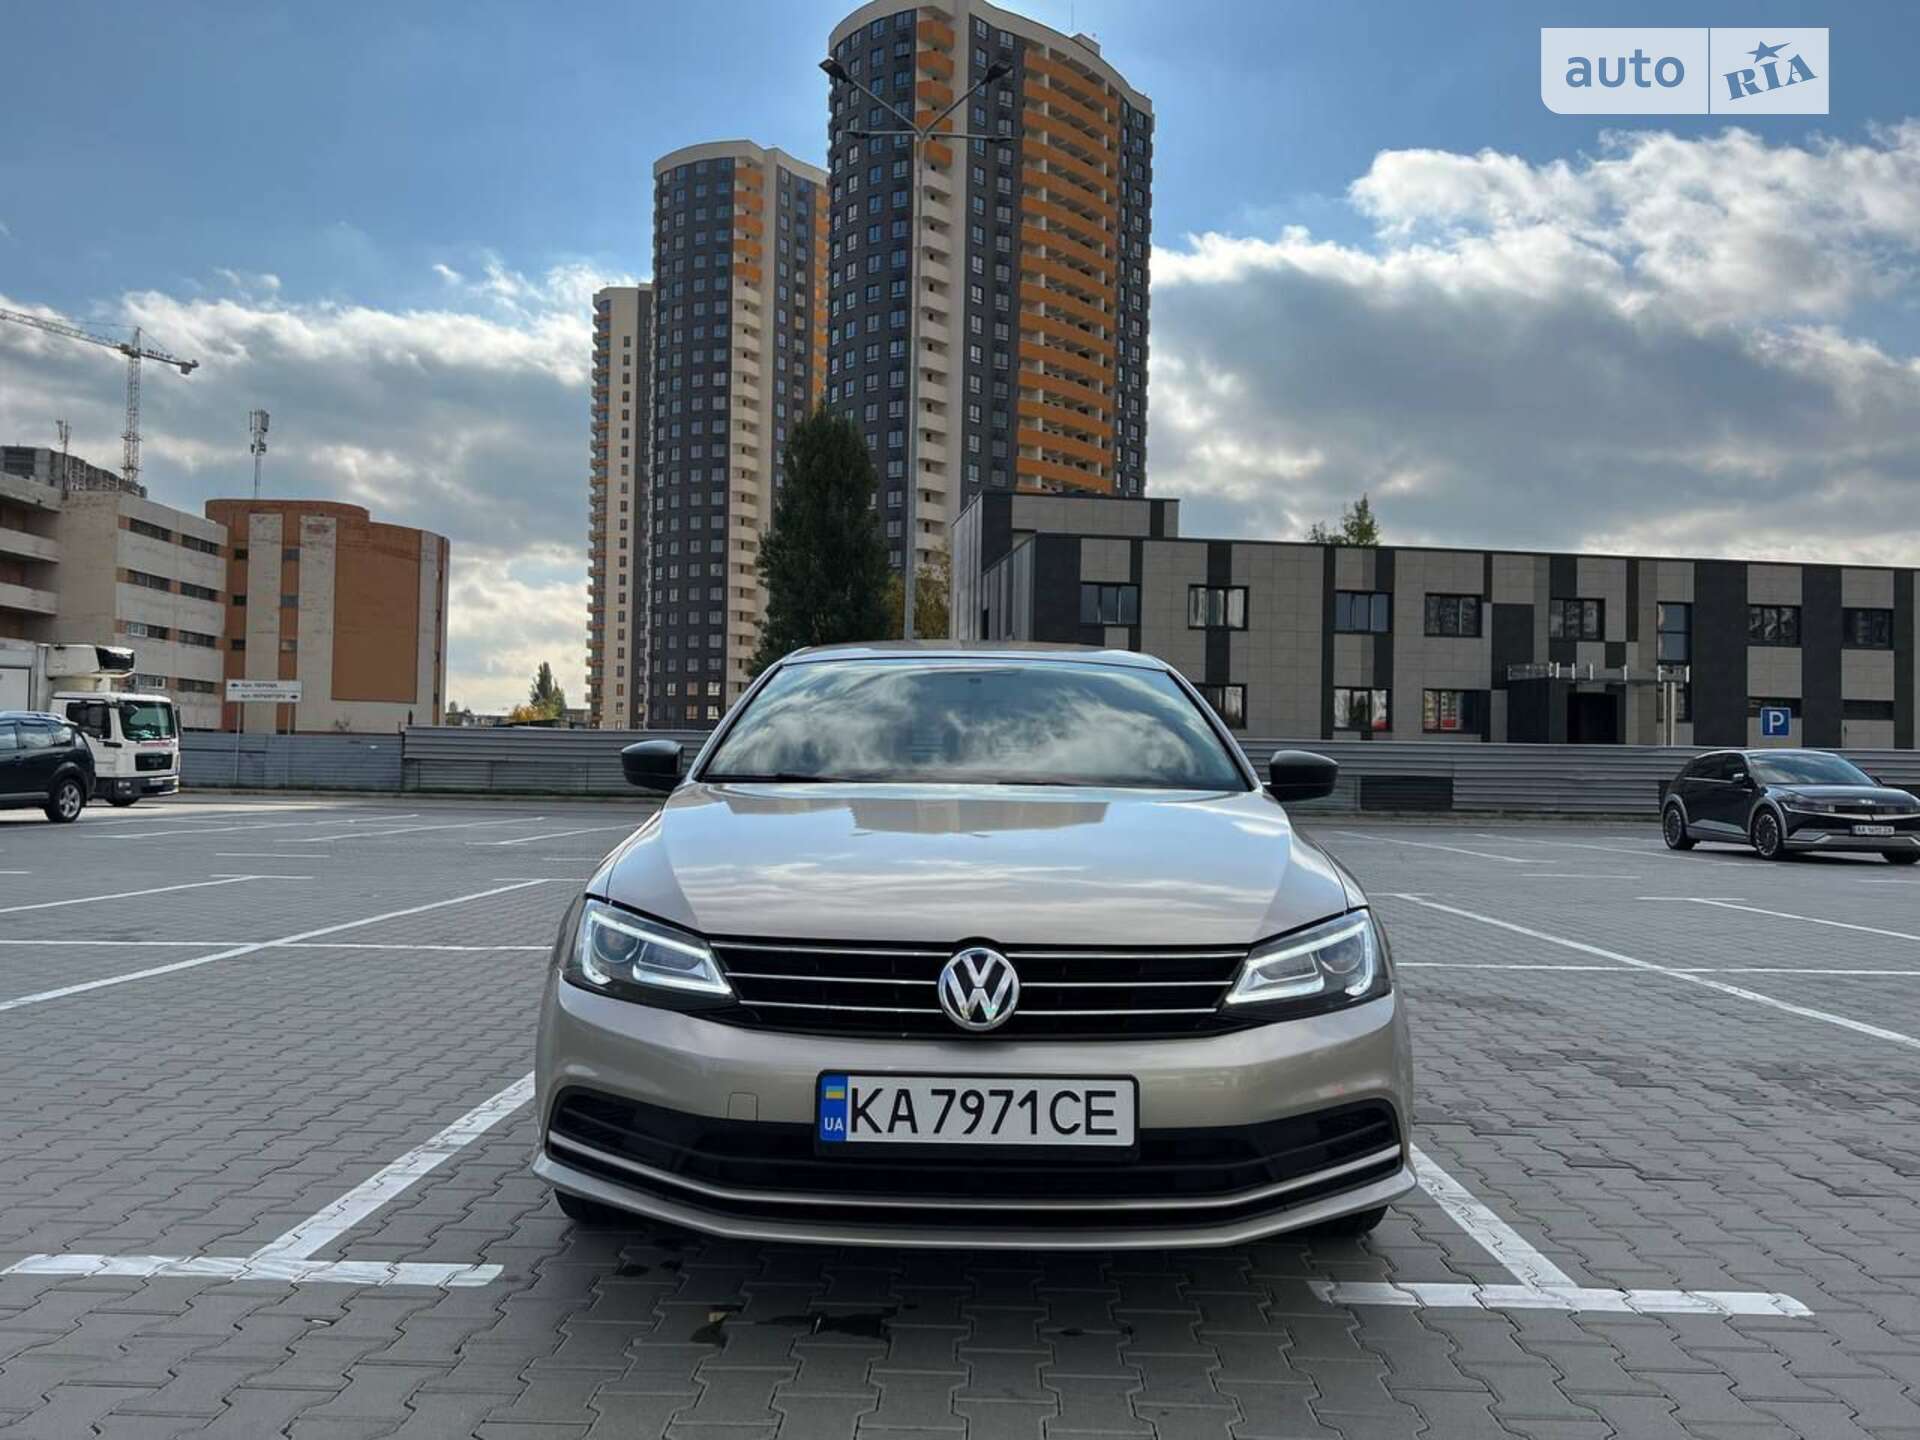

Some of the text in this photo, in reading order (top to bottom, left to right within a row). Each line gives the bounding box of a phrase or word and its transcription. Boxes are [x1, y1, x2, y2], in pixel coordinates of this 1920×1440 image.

[1769, 710, 1785, 734] P
[850, 1087, 1118, 1136] KA 7971 CE
[824, 1116, 845, 1132] UA
